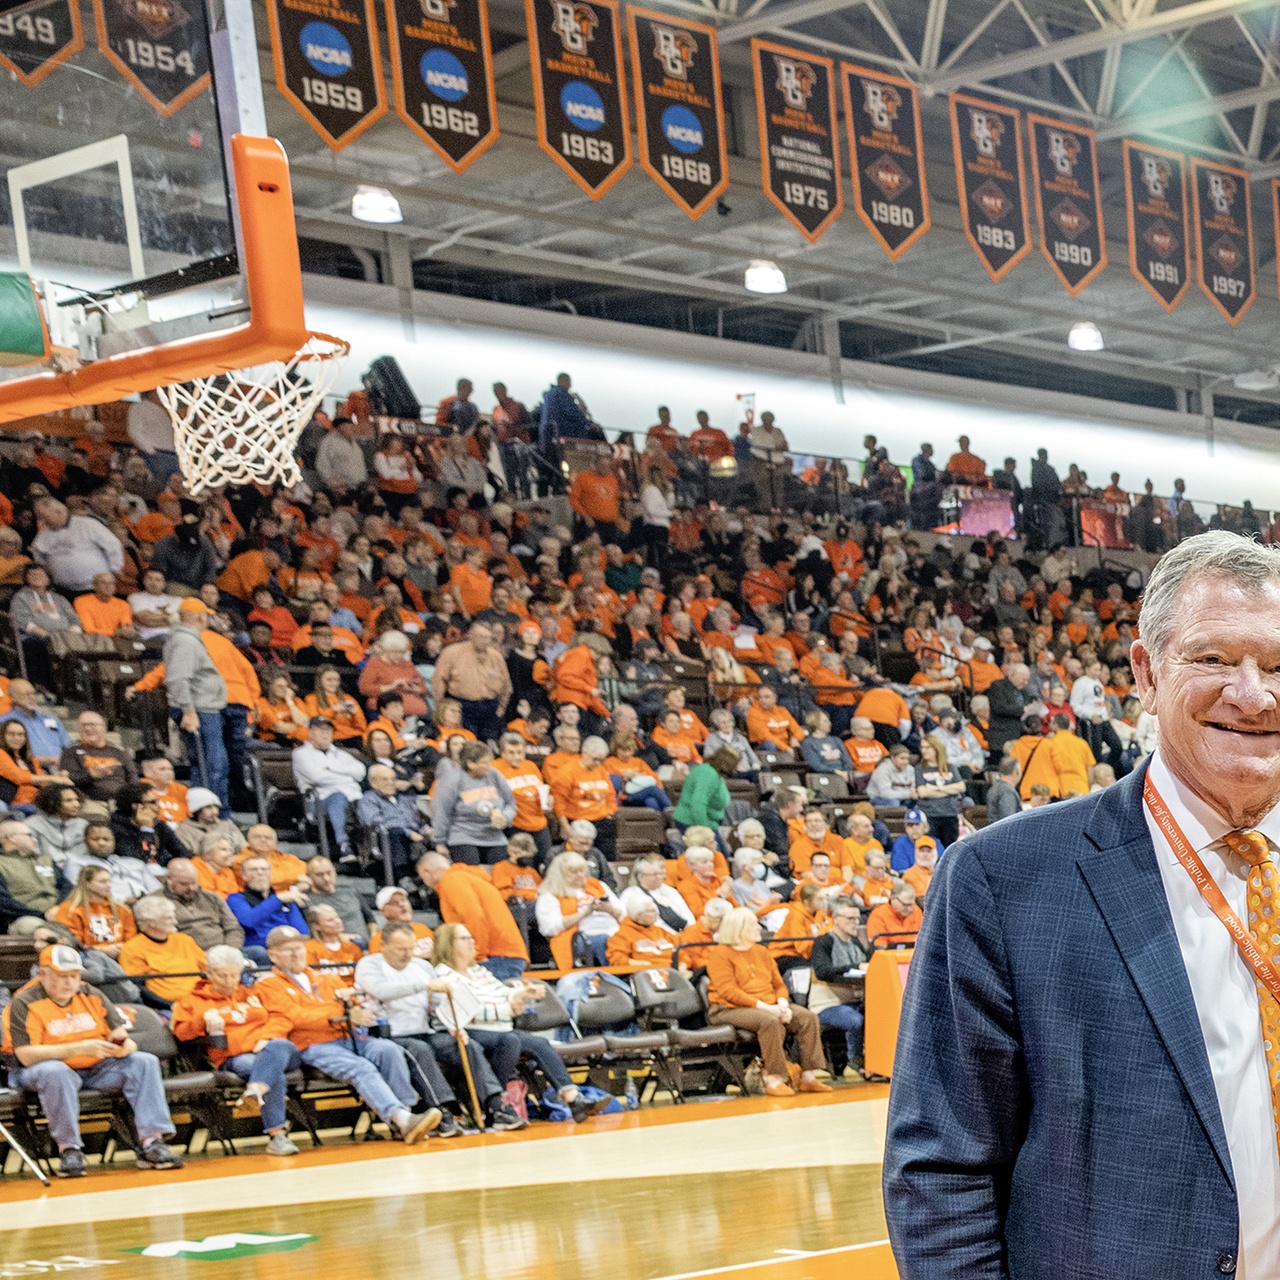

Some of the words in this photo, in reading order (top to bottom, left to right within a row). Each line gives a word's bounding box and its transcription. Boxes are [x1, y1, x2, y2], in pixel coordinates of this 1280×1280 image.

[0, 12, 56, 45] 949
[125, 37, 196, 76] 1954
[306, 43, 352, 68] NCAA
[301, 76, 364, 113] 1959
[426, 69, 469, 94] NCAA
[421, 102, 480, 137] 1962
[566, 100, 606, 124] NCAA
[561, 132, 614, 165] 1963
[666, 124, 704, 147] NCAA
[661, 154, 712, 186] 1968
[782, 181, 829, 211] 1975
[871, 200, 915, 229] 1980
[976, 223, 1016, 251] 1983
[1054, 241, 1093, 267] 1990
[1148, 261, 1180, 285] 1991
[1212, 275, 1246, 299] 1997
[1148, 793, 1158, 805] the
[1153, 804, 1168, 817] for
[1161, 815, 1188, 857] University
[1186, 856, 1206, 884] Public
[1202, 883, 1212, 891] A
[1222, 914, 1245, 940] Good.
[1243, 939, 1264, 968] Public
[1261, 965, 1273, 979] the
